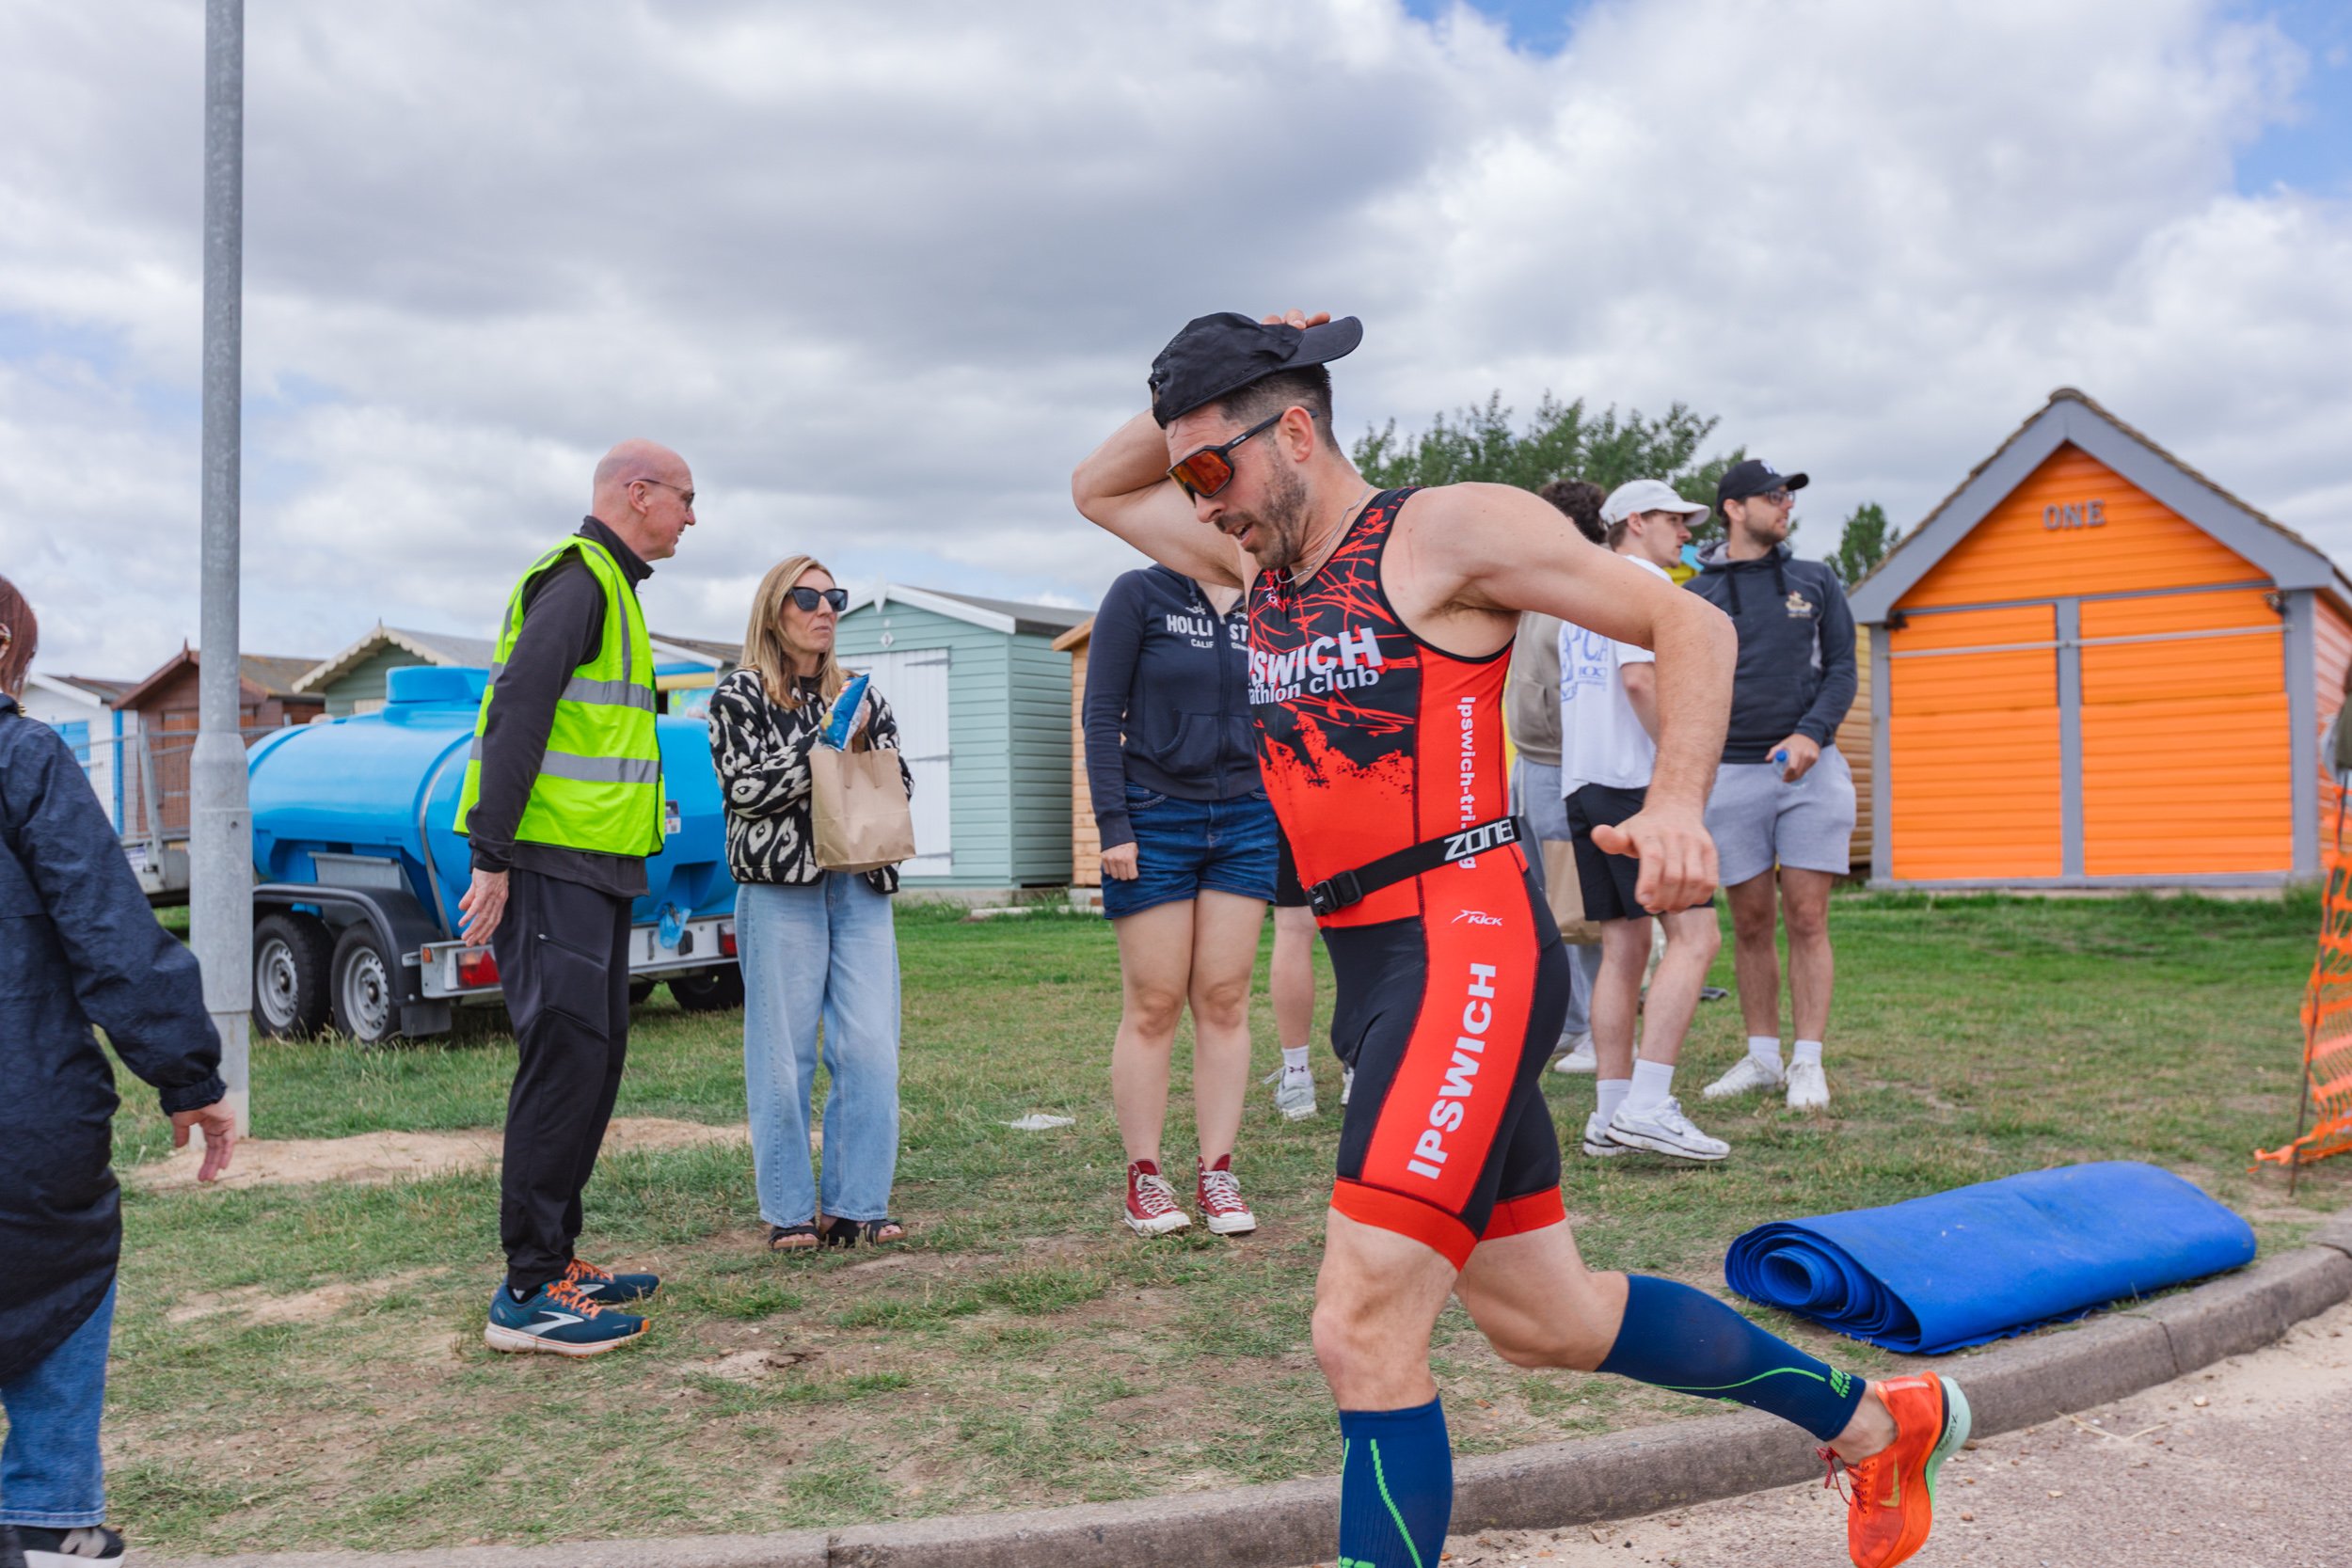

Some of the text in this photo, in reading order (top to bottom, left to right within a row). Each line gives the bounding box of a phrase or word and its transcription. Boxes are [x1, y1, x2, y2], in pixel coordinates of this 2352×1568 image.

[2042, 498, 2106, 531] ONE
[1166, 614, 1249, 642] HOLLI ST
[1190, 639, 1215, 649] CALIF
[1248, 664, 1379, 705] athlon club
[1457, 697, 1477, 869] Ipswich-tri.g
[1406, 962, 1497, 1180] IPSWICH
